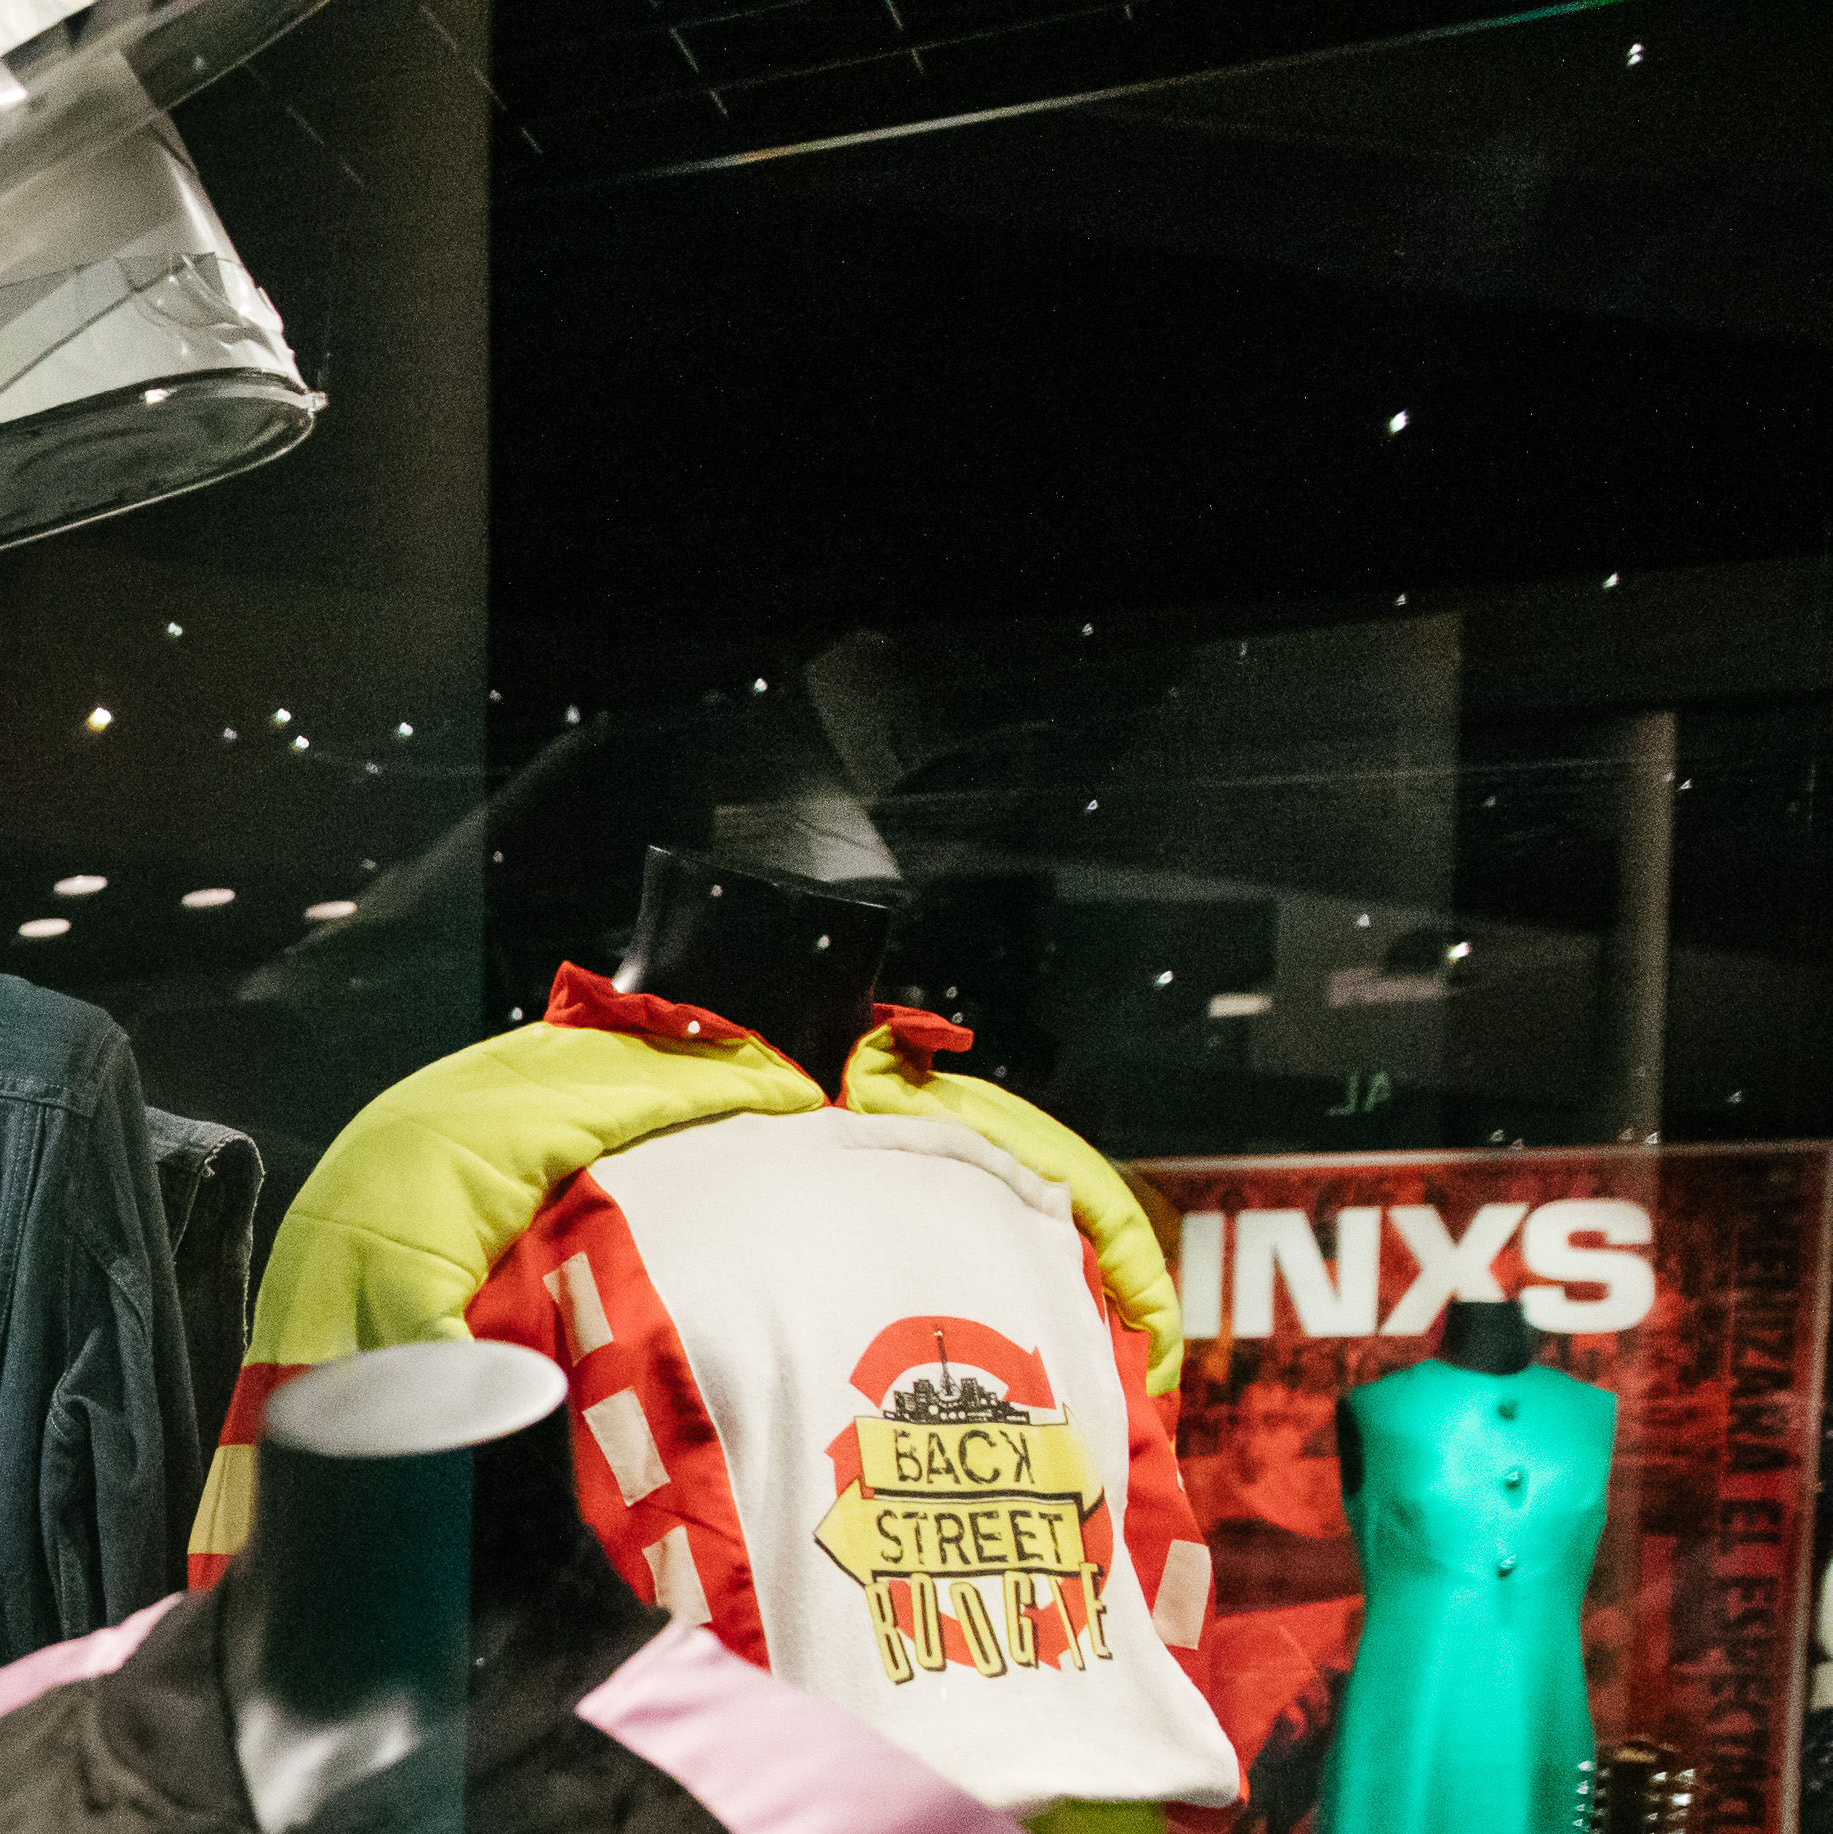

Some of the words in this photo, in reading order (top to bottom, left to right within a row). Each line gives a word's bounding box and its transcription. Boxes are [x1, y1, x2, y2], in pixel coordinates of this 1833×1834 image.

[1181, 1197, 1656, 1339] INXS
[894, 1428, 1036, 1485] BACK
[876, 1508, 1065, 1566] STREET
[864, 1557, 1113, 1686] BOOGIE
